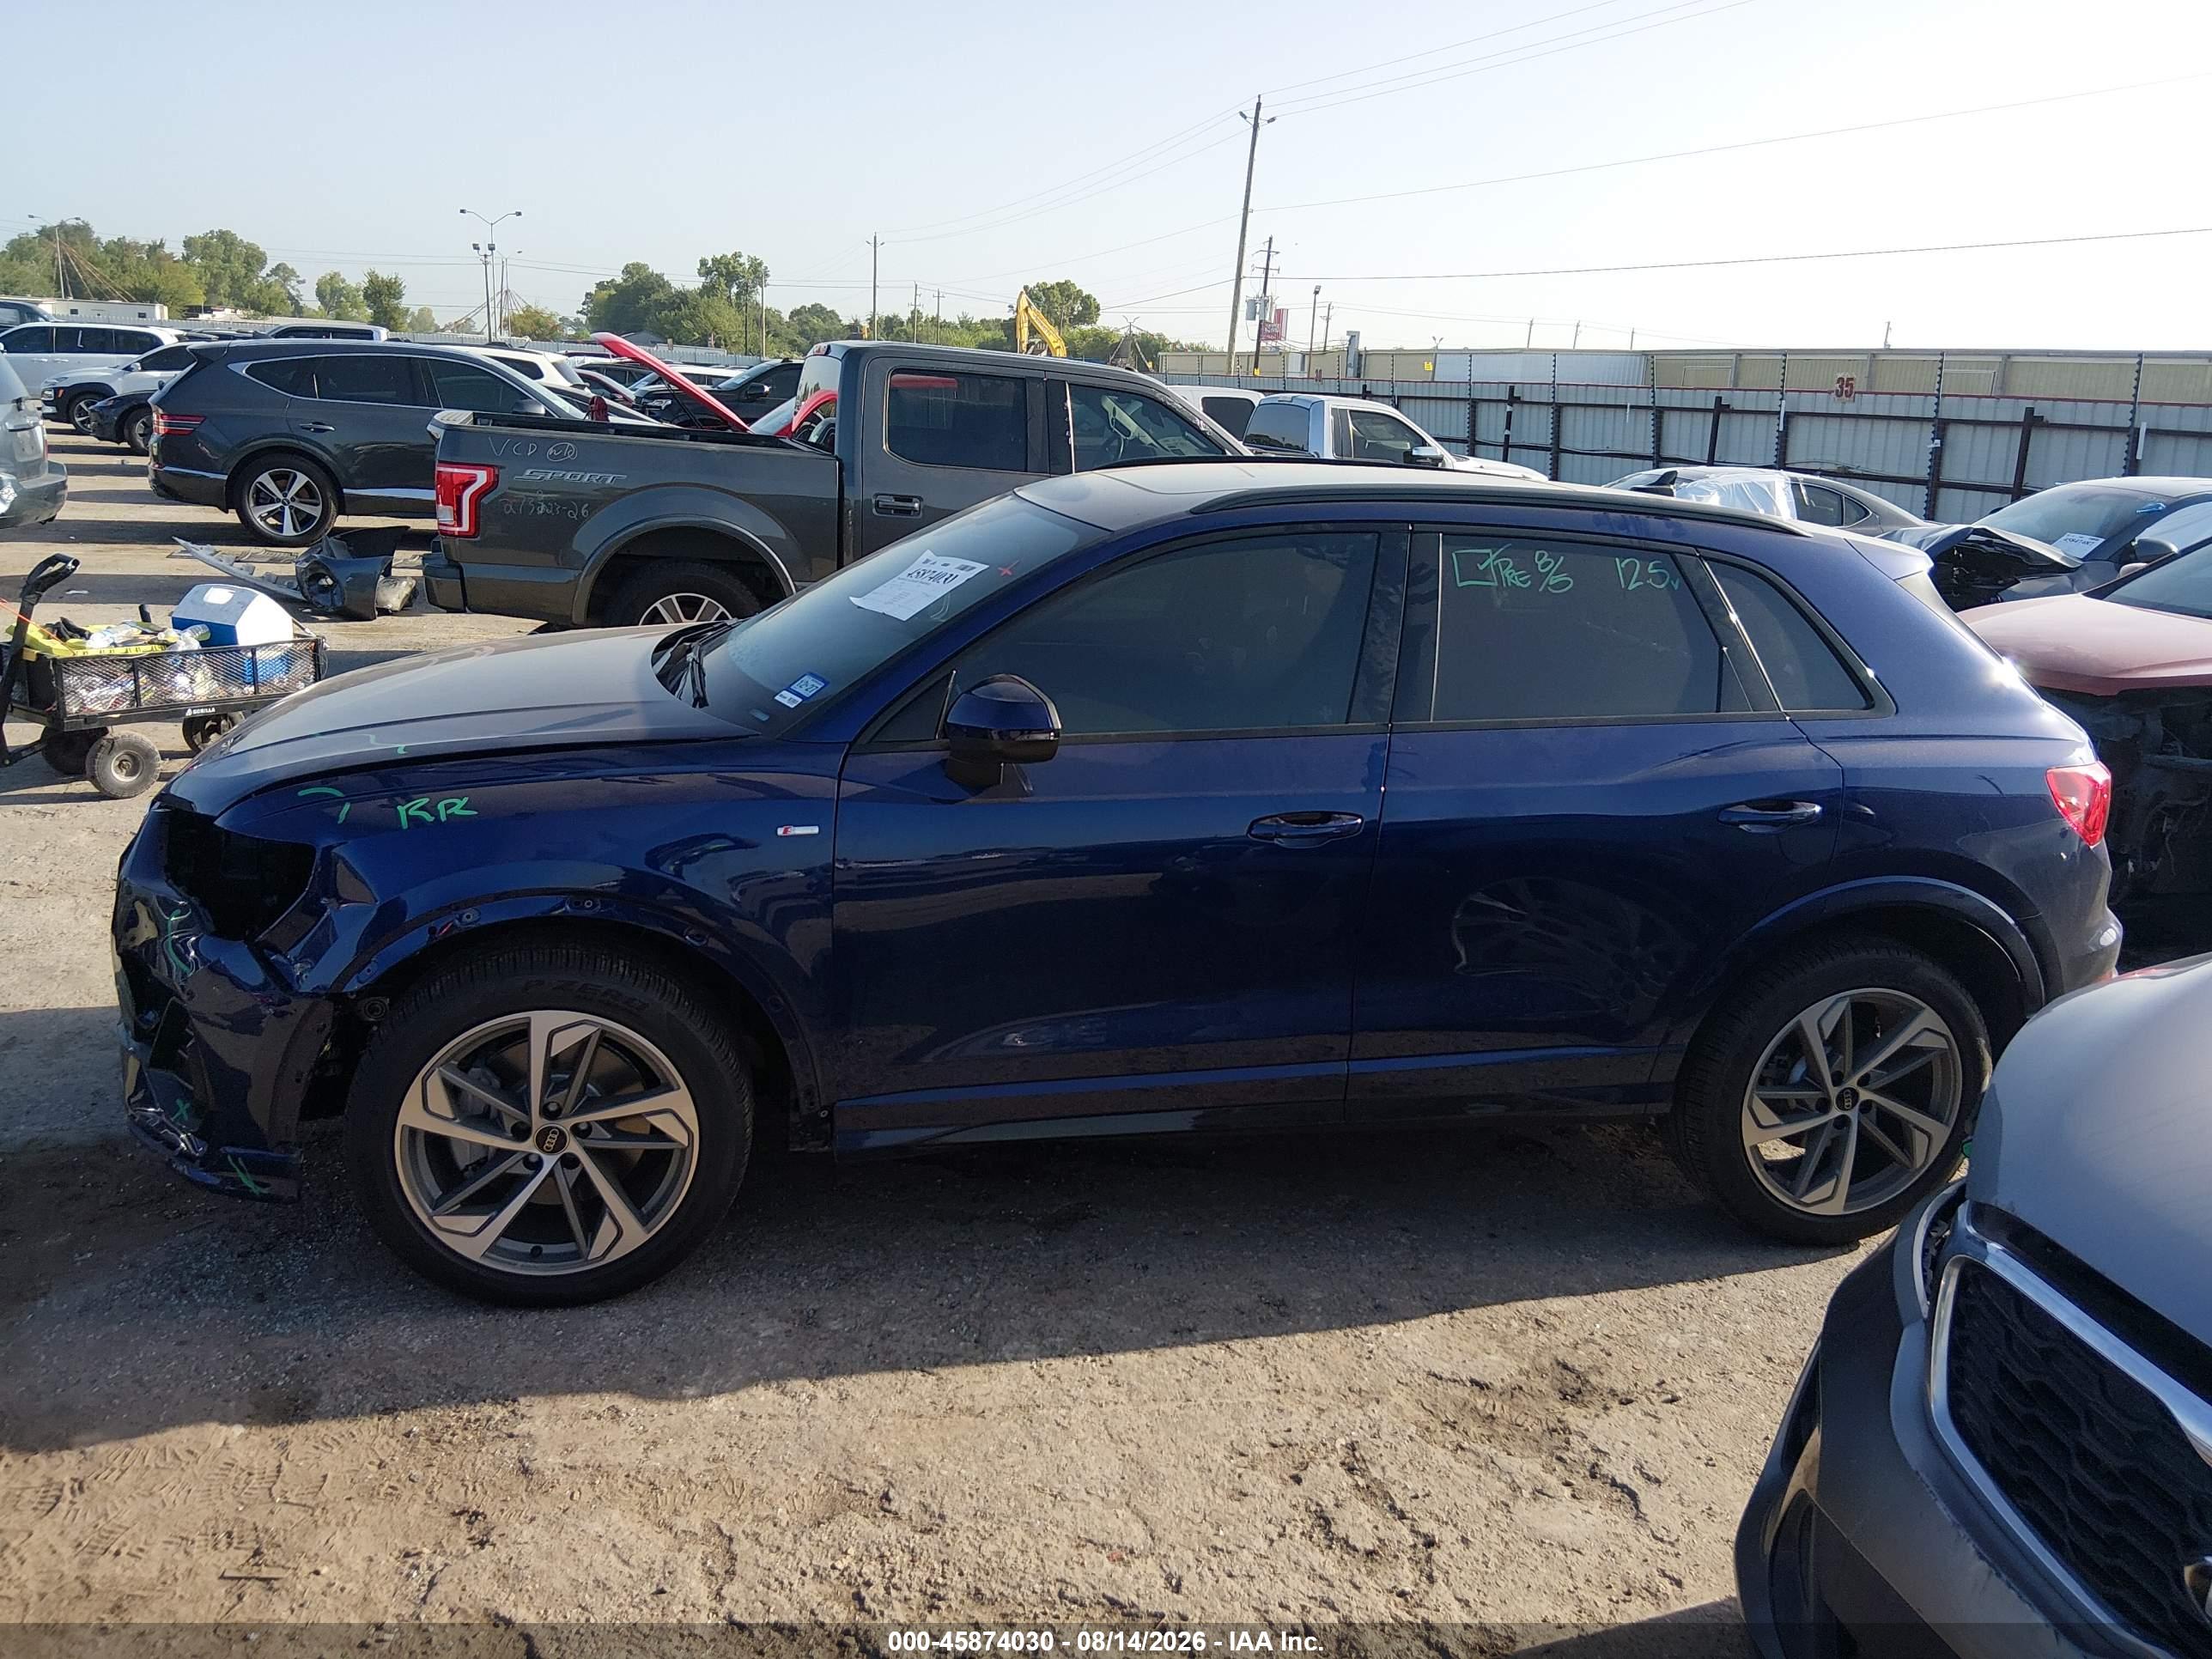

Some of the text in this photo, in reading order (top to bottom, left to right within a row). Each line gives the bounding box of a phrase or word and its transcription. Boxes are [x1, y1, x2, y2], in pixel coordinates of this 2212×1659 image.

[1835, 377, 1855, 398] 35
[488, 436, 538, 457] VCD
[514, 468, 627, 484] SPORT
